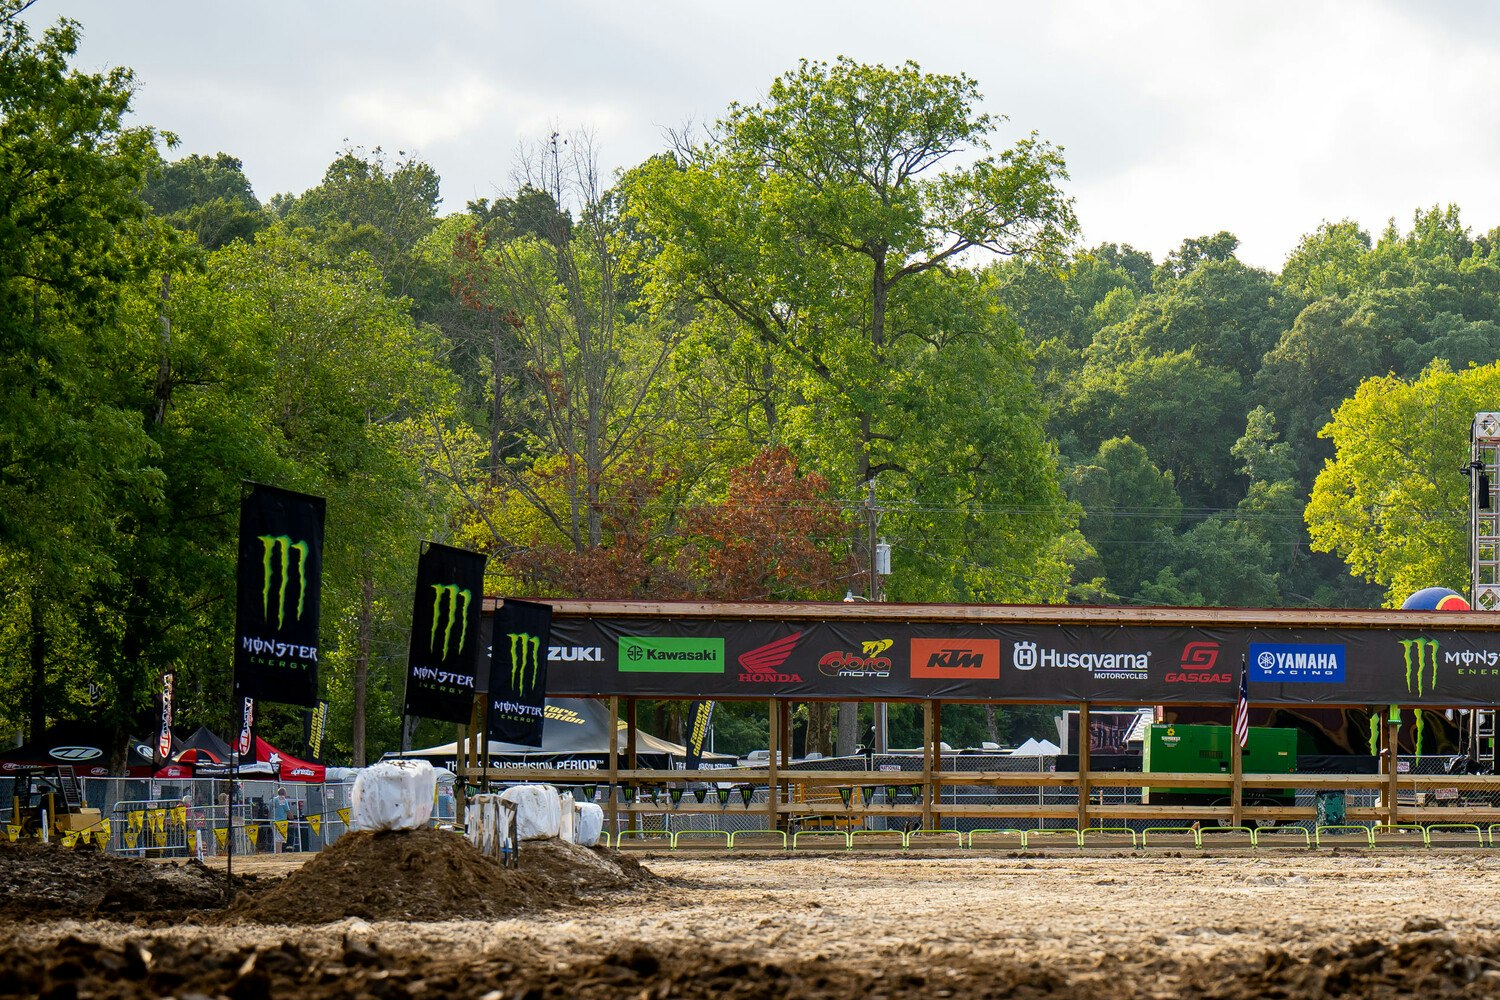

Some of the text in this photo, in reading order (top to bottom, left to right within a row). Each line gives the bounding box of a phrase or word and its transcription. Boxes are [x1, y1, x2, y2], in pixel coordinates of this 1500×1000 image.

[243, 636, 318, 662] MONSTER
[547, 646, 602, 661] ZUKI
[646, 648, 717, 661] Kawasaki
[250, 656, 308, 670] ENERGY
[818, 651, 891, 677] Cobra
[926, 649, 984, 668] KTM
[1040, 649, 1149, 671] Husqvarna
[1275, 653, 1338, 669] YAMAHA
[413, 666, 474, 688] MONSTER
[738, 673, 804, 683] HONDA
[1165, 673, 1233, 683] GASGAS
[494, 701, 543, 717] MONSTER
[501, 714, 535, 723] ENERGY
